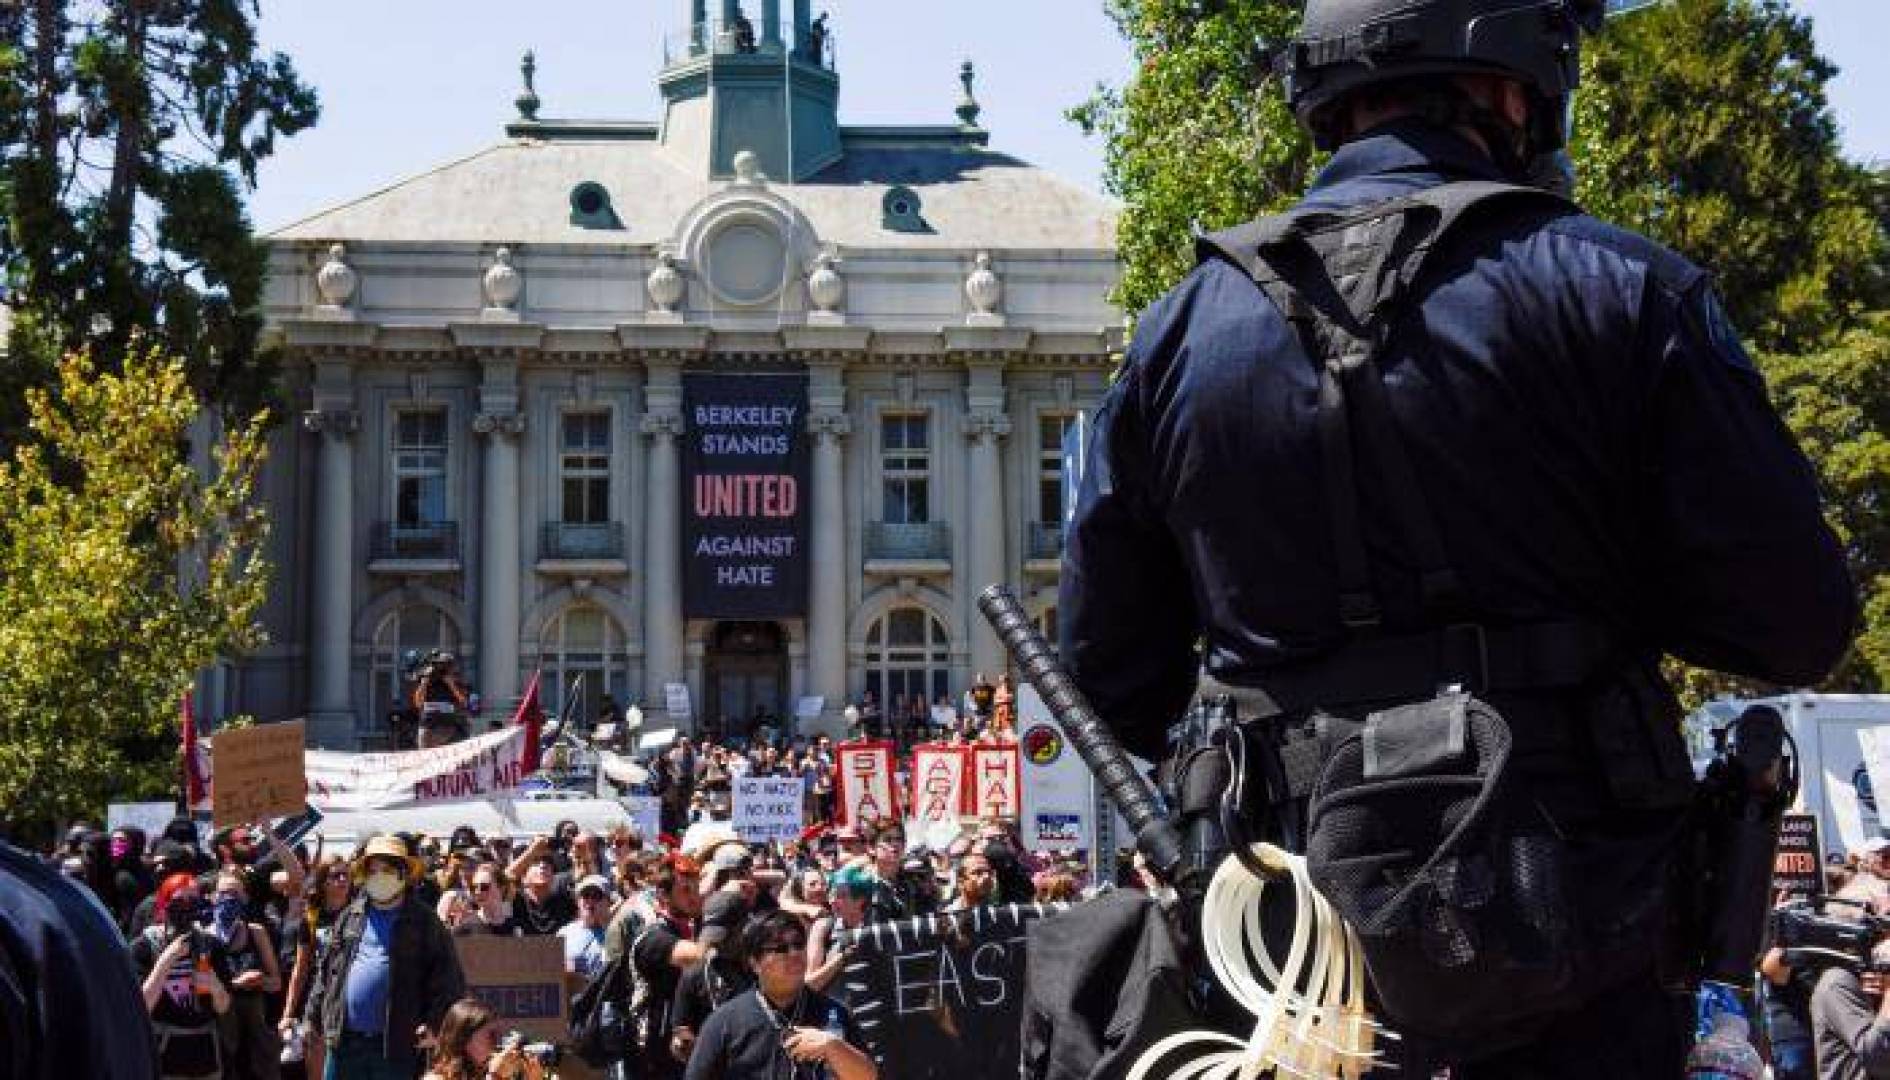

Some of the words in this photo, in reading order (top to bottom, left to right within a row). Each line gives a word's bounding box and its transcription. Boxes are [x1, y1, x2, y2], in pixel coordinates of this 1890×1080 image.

[695, 406, 796, 425] BERKELEY
[702, 434, 788, 454] STANDS
[695, 475, 797, 517] UNITED
[697, 536, 794, 557] AGAINST
[717, 565, 774, 584] HATE
[739, 783, 757, 795] NO
[853, 753, 880, 832] STA
[745, 803, 764, 817] NO
